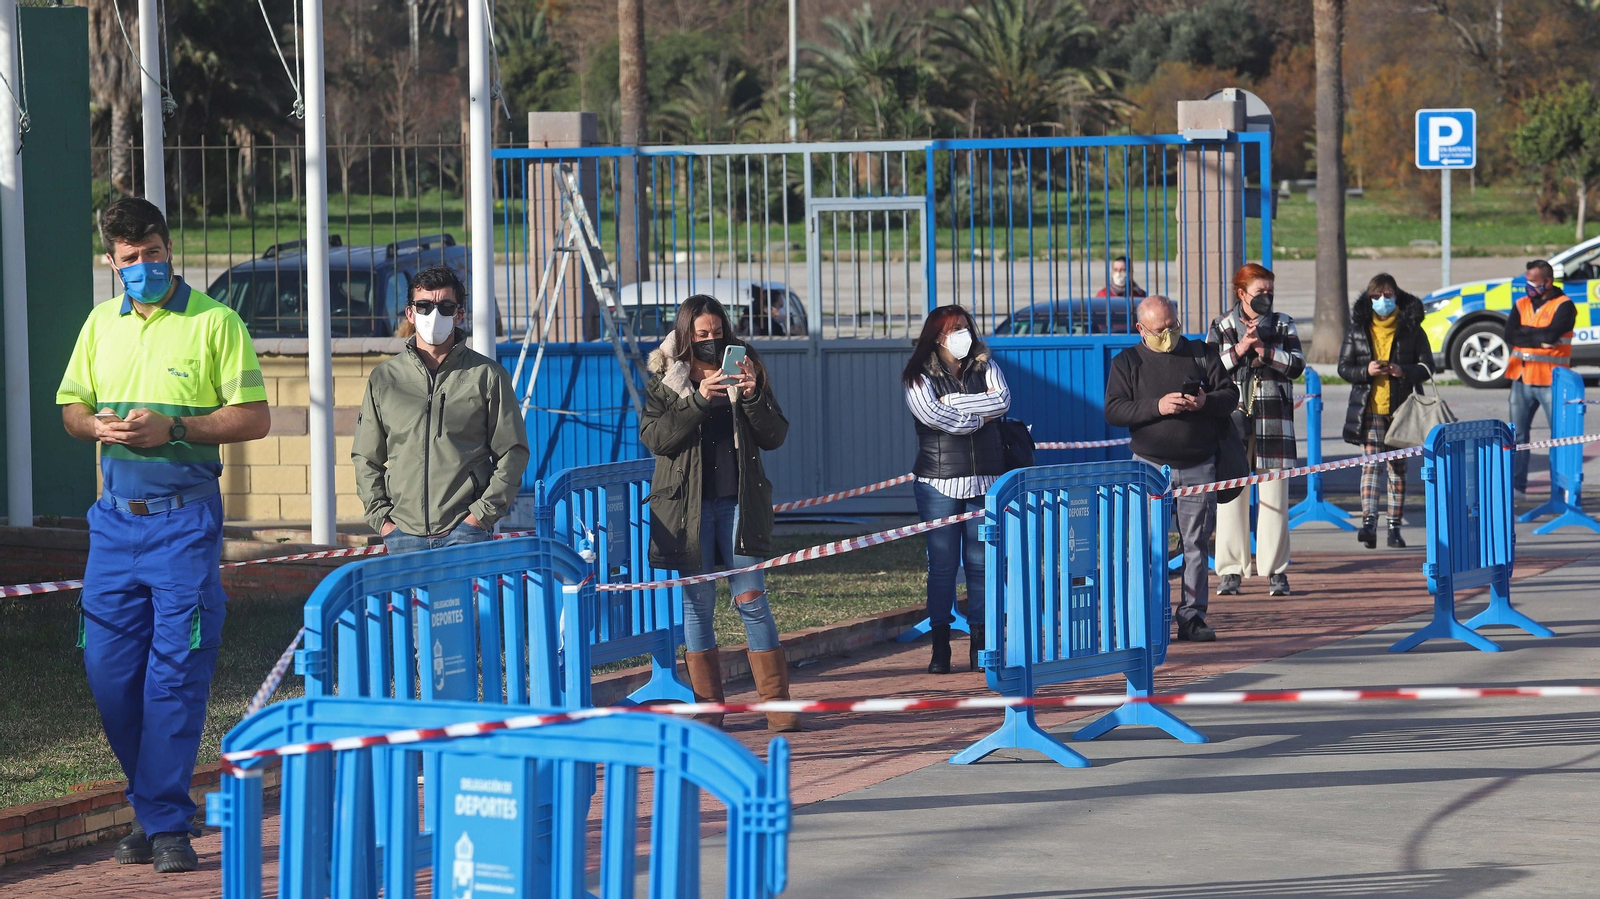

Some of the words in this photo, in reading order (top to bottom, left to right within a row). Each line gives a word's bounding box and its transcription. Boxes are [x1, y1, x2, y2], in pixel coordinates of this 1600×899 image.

[1429, 116, 1463, 161] P
[607, 502, 624, 513] DEPORTES
[1069, 507, 1089, 517] DEPORTES
[433, 598, 455, 609] DELEGACIÓN
[455, 597, 461, 606] DE
[431, 609, 463, 627] DEPORTES
[455, 794, 517, 820] DEPORTES
